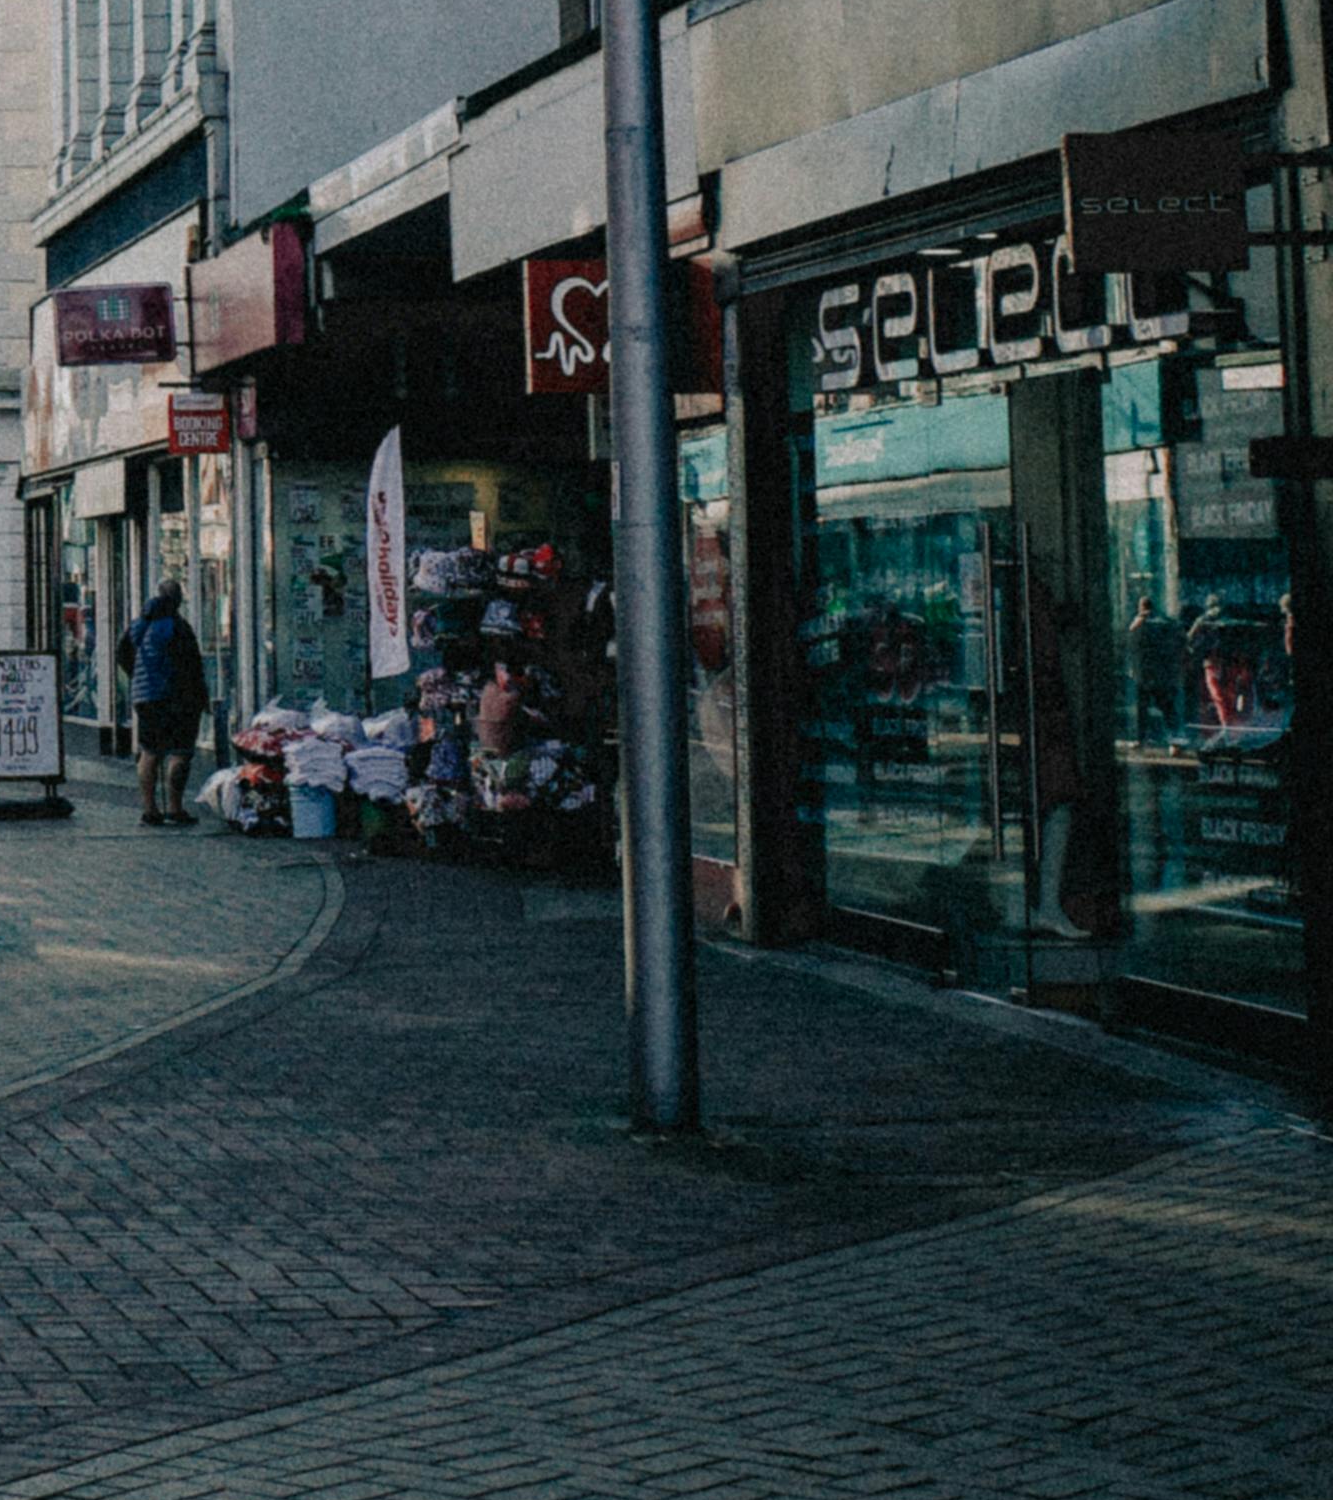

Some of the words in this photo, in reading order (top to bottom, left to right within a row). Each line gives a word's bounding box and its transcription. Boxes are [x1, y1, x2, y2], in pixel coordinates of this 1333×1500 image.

[62, 327, 126, 345] POLKA
[131, 324, 166, 339] DOT
[173, 415, 223, 431] BOOKING
[178, 431, 218, 447] CENTRE
